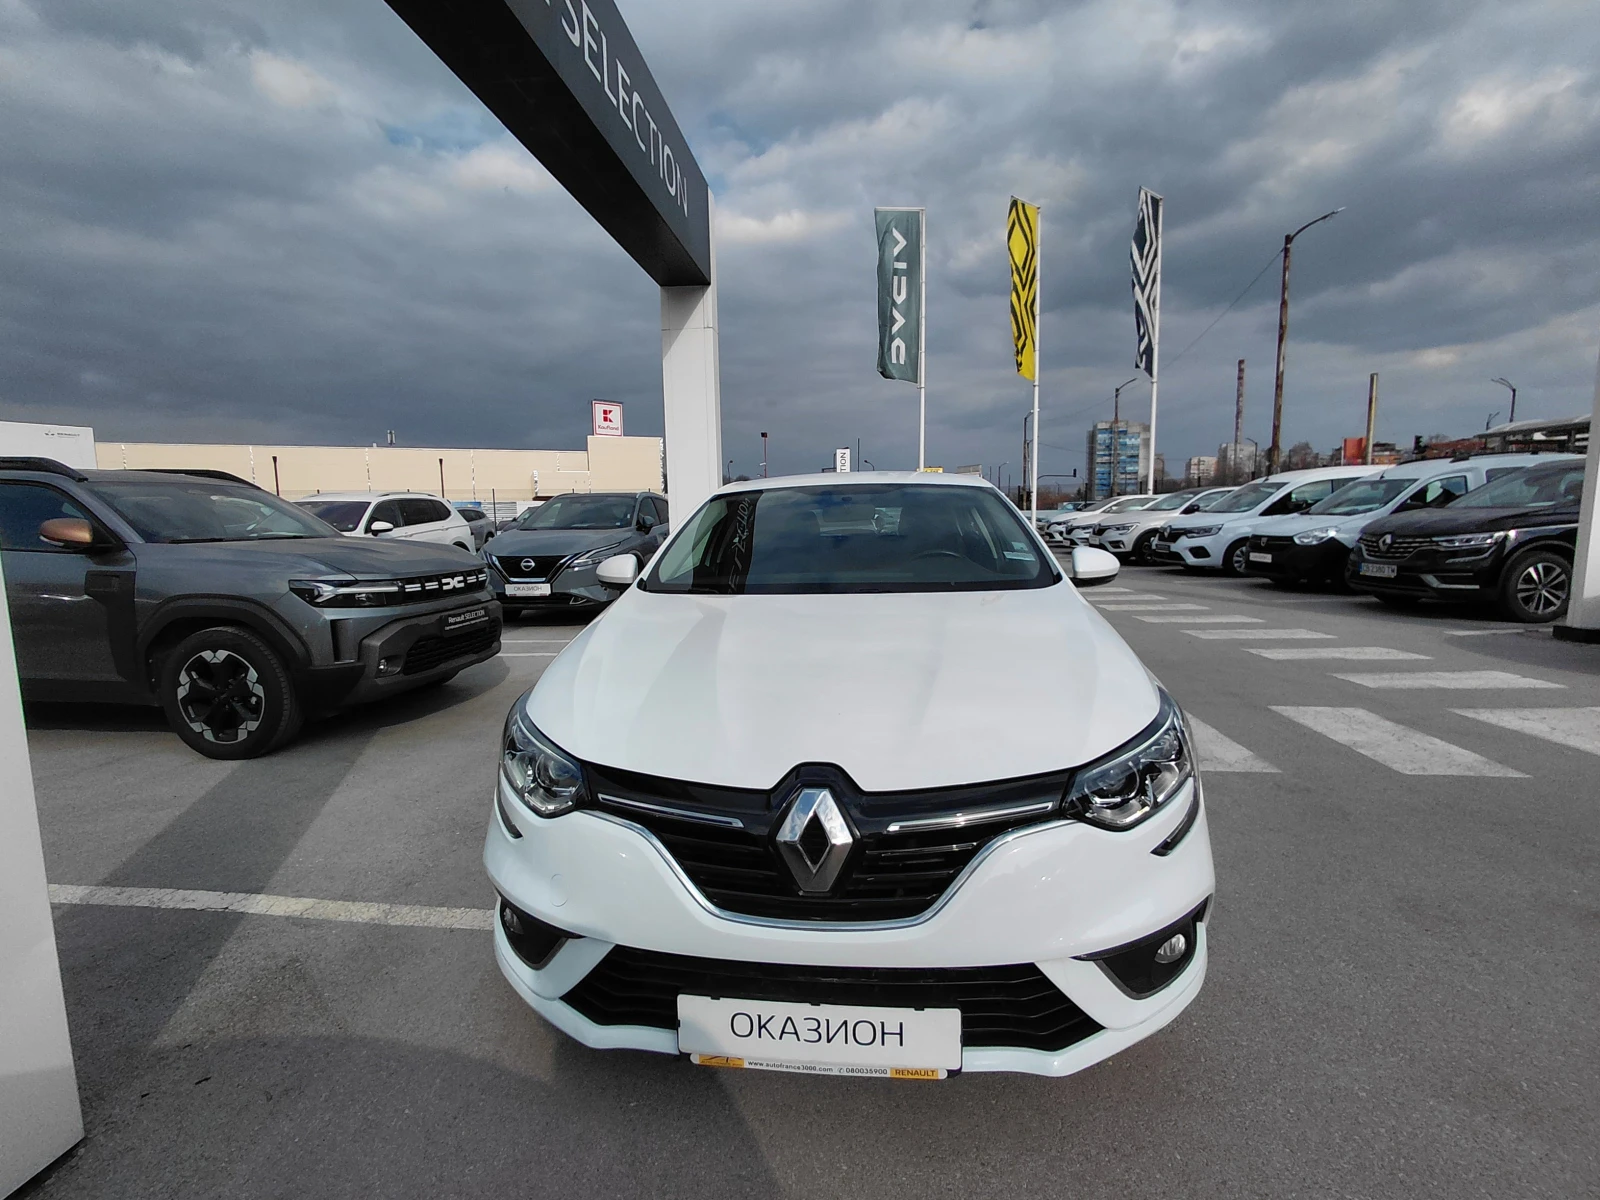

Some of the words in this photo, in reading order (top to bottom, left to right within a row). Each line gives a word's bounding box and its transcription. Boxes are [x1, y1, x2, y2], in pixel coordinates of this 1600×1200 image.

[561, 0, 688, 218] SELECTION
[448, 614, 465, 624] Renault
[464, 609, 486, 620] SELECTION
[730, 1012, 904, 1047] ОКАЗИОН
[747, 1059, 834, 1073] www.autofrance3000.com
[845, 1067, 888, 1076] 080035900
[895, 1068, 936, 1078] RENAULT
